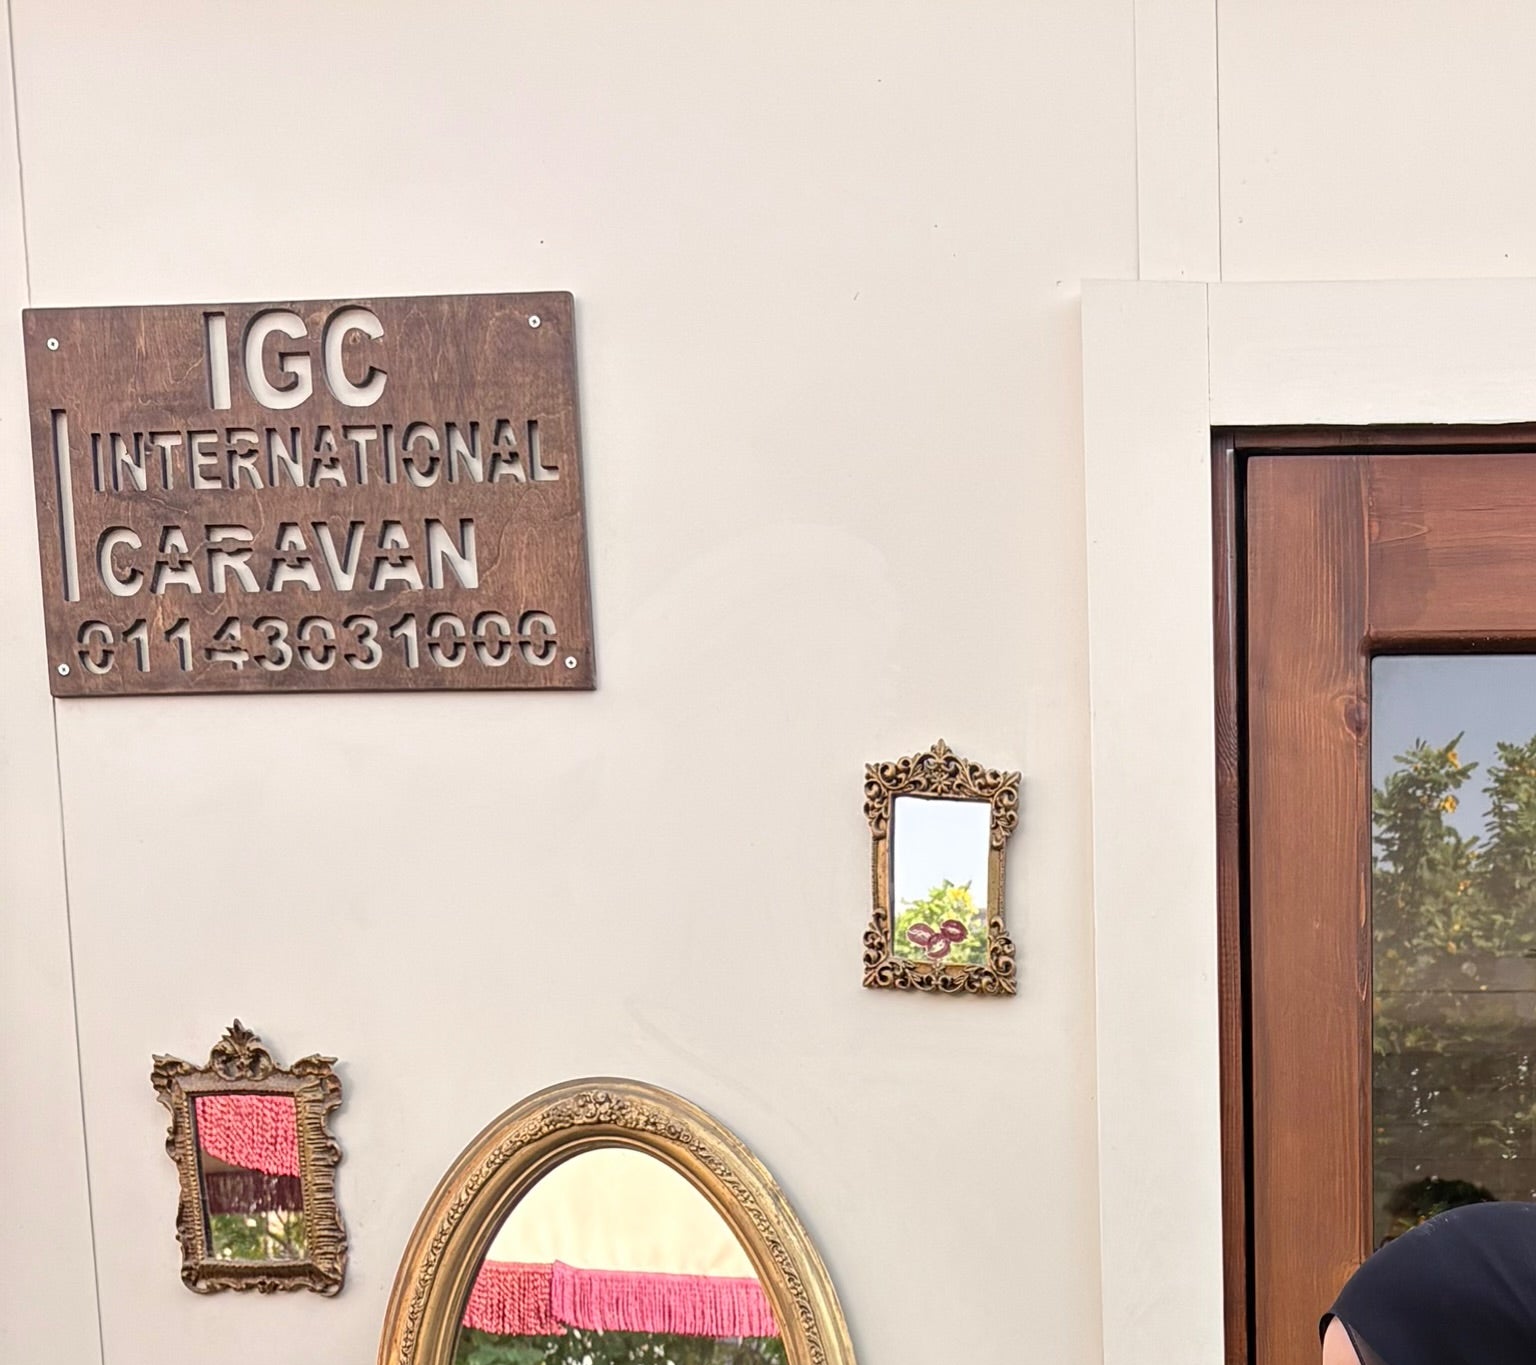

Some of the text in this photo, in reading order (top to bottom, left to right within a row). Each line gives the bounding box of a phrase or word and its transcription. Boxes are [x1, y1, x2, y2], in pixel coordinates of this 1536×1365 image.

[202, 304, 388, 410] IGC
[91, 419, 559, 492] INTERNATIONAL
[96, 518, 479, 597] CARAVAN
[76, 610, 557, 674] 01143031000
